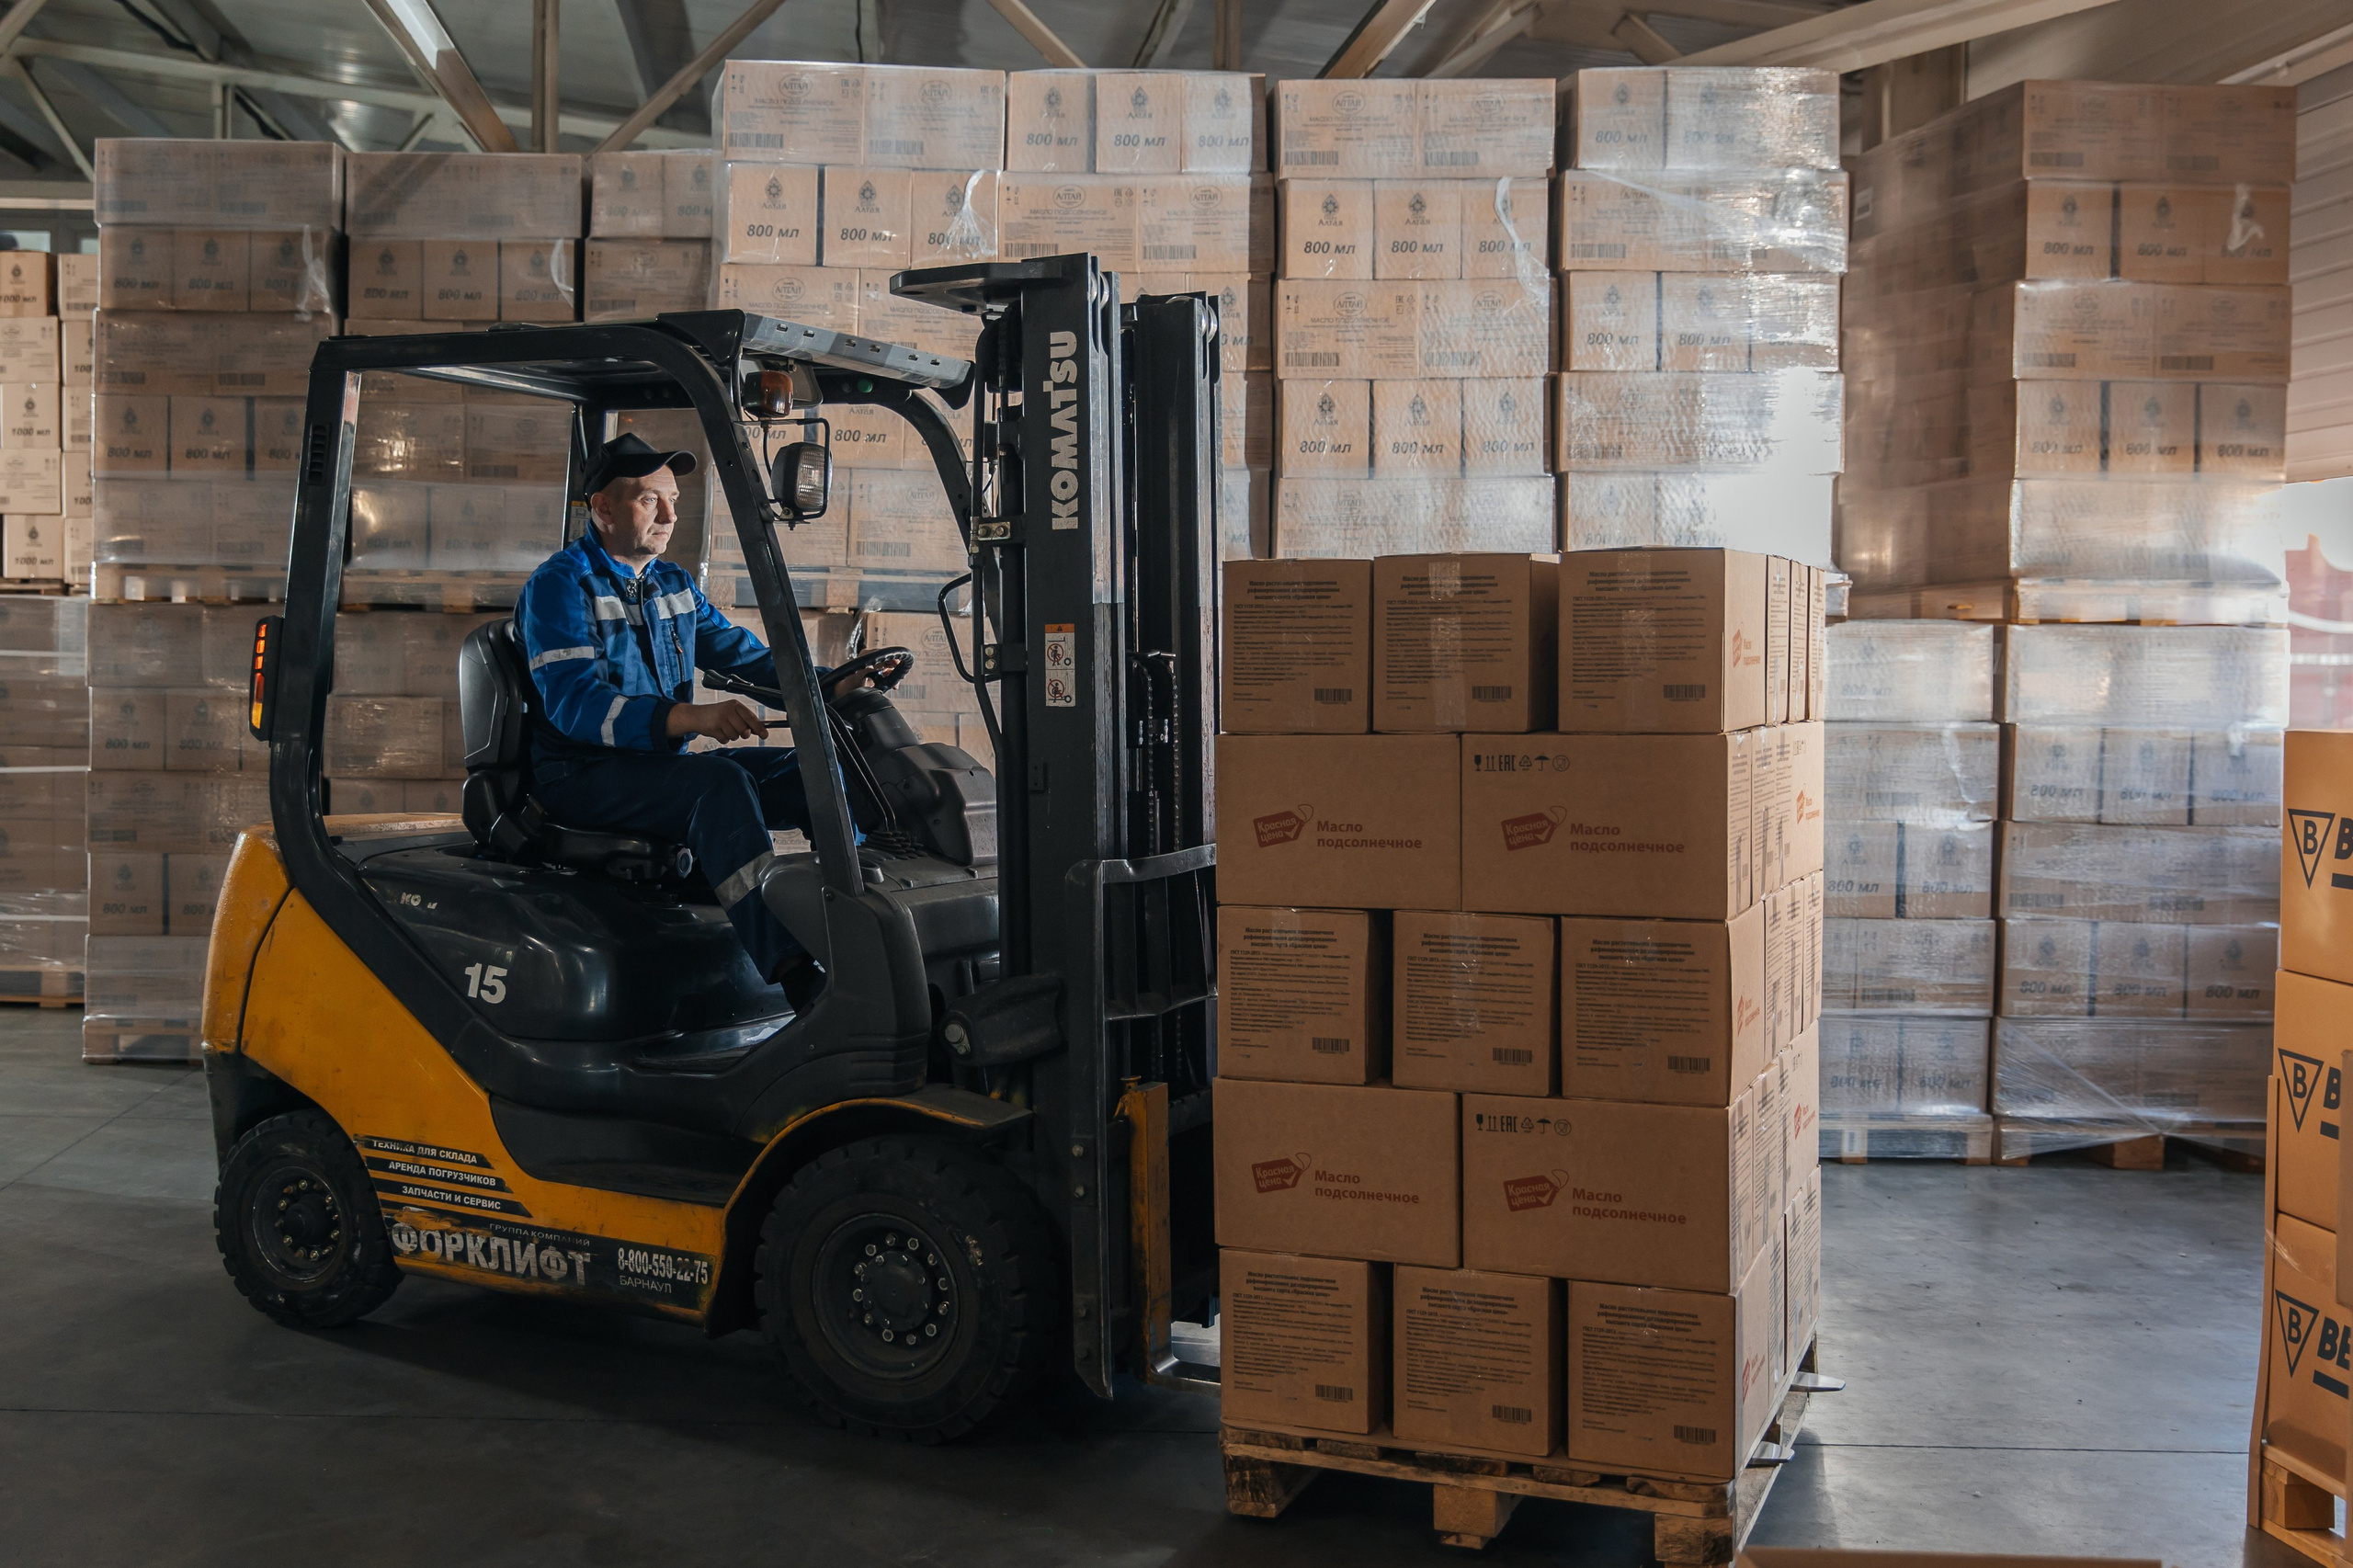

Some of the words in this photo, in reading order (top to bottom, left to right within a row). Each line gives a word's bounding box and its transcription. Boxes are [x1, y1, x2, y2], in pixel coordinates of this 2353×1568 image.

[1026, 132, 1052, 146] 800
[1057, 135, 1078, 147] мл
[1113, 133, 1140, 147] 800
[1144, 136, 1166, 148] мл
[1198, 134, 1224, 148] 800
[1228, 137, 1249, 149] мл
[1595, 131, 1621, 144] 800
[1626, 132, 1648, 144] мл
[1056, 193, 1083, 201] АЛТАЙ
[746, 224, 773, 238] 800
[778, 227, 800, 239] мл
[840, 227, 867, 242] 800
[1303, 241, 1330, 255] 800
[1334, 243, 1356, 255] мл
[1391, 240, 1417, 254] 800
[1422, 242, 1444, 254] мл
[1478, 240, 1506, 253] 800
[2043, 242, 2070, 256] 800
[1586, 332, 1613, 346] 800
[1618, 335, 1639, 346] мл
[1678, 332, 1705, 346] 800
[1710, 335, 1731, 346] мл
[835, 428, 863, 442] 800
[867, 430, 887, 443] мл
[1043, 331, 1078, 529] KOMATSU
[1300, 440, 1325, 454] 800
[1330, 443, 1352, 454] мл
[1392, 441, 1418, 455] 800
[1422, 443, 1444, 455] мл
[1482, 439, 1508, 453] 800
[1513, 441, 1535, 452] мл
[1256, 817, 1298, 834] Красная
[1317, 821, 1363, 833] Масло
[1506, 819, 1549, 836] Красная
[1570, 824, 1620, 836] Масло
[1260, 831, 1284, 842] цена
[1317, 837, 1422, 849] подсолнечное
[1509, 833, 1534, 846] цена
[1570, 841, 1685, 854] подсолнечное
[464, 962, 508, 1005] 15
[2206, 985, 2233, 999] 800
[2237, 986, 2260, 1000] мл
[417, 1146, 437, 1157] ДЛЯ
[439, 1150, 478, 1164] СКЛАДА
[389, 1161, 426, 1176] АРЕНДА
[428, 1167, 496, 1187] ПОГРУЗЧИКОВ
[1256, 1165, 1294, 1179] Красная
[1314, 1170, 1360, 1185] Масло
[1259, 1177, 1282, 1188] цена
[1507, 1182, 1551, 1197] Красная
[402, 1186, 452, 1201] ЗАПЧАСТИ
[454, 1194, 461, 1203] И
[463, 1197, 501, 1210] СЕРВИС
[1314, 1187, 1420, 1204] подсолнечное
[1511, 1195, 1536, 1207] цена
[1572, 1187, 1622, 1203] Масло
[1572, 1206, 1688, 1224] подсолнечное
[489, 1222, 529, 1237] ГРУППА
[529, 1232, 591, 1247] КОМПАНИЙ
[392, 1221, 591, 1286] ФОРКЛИФТ
[619, 1275, 673, 1294] БАРНАУЛ
